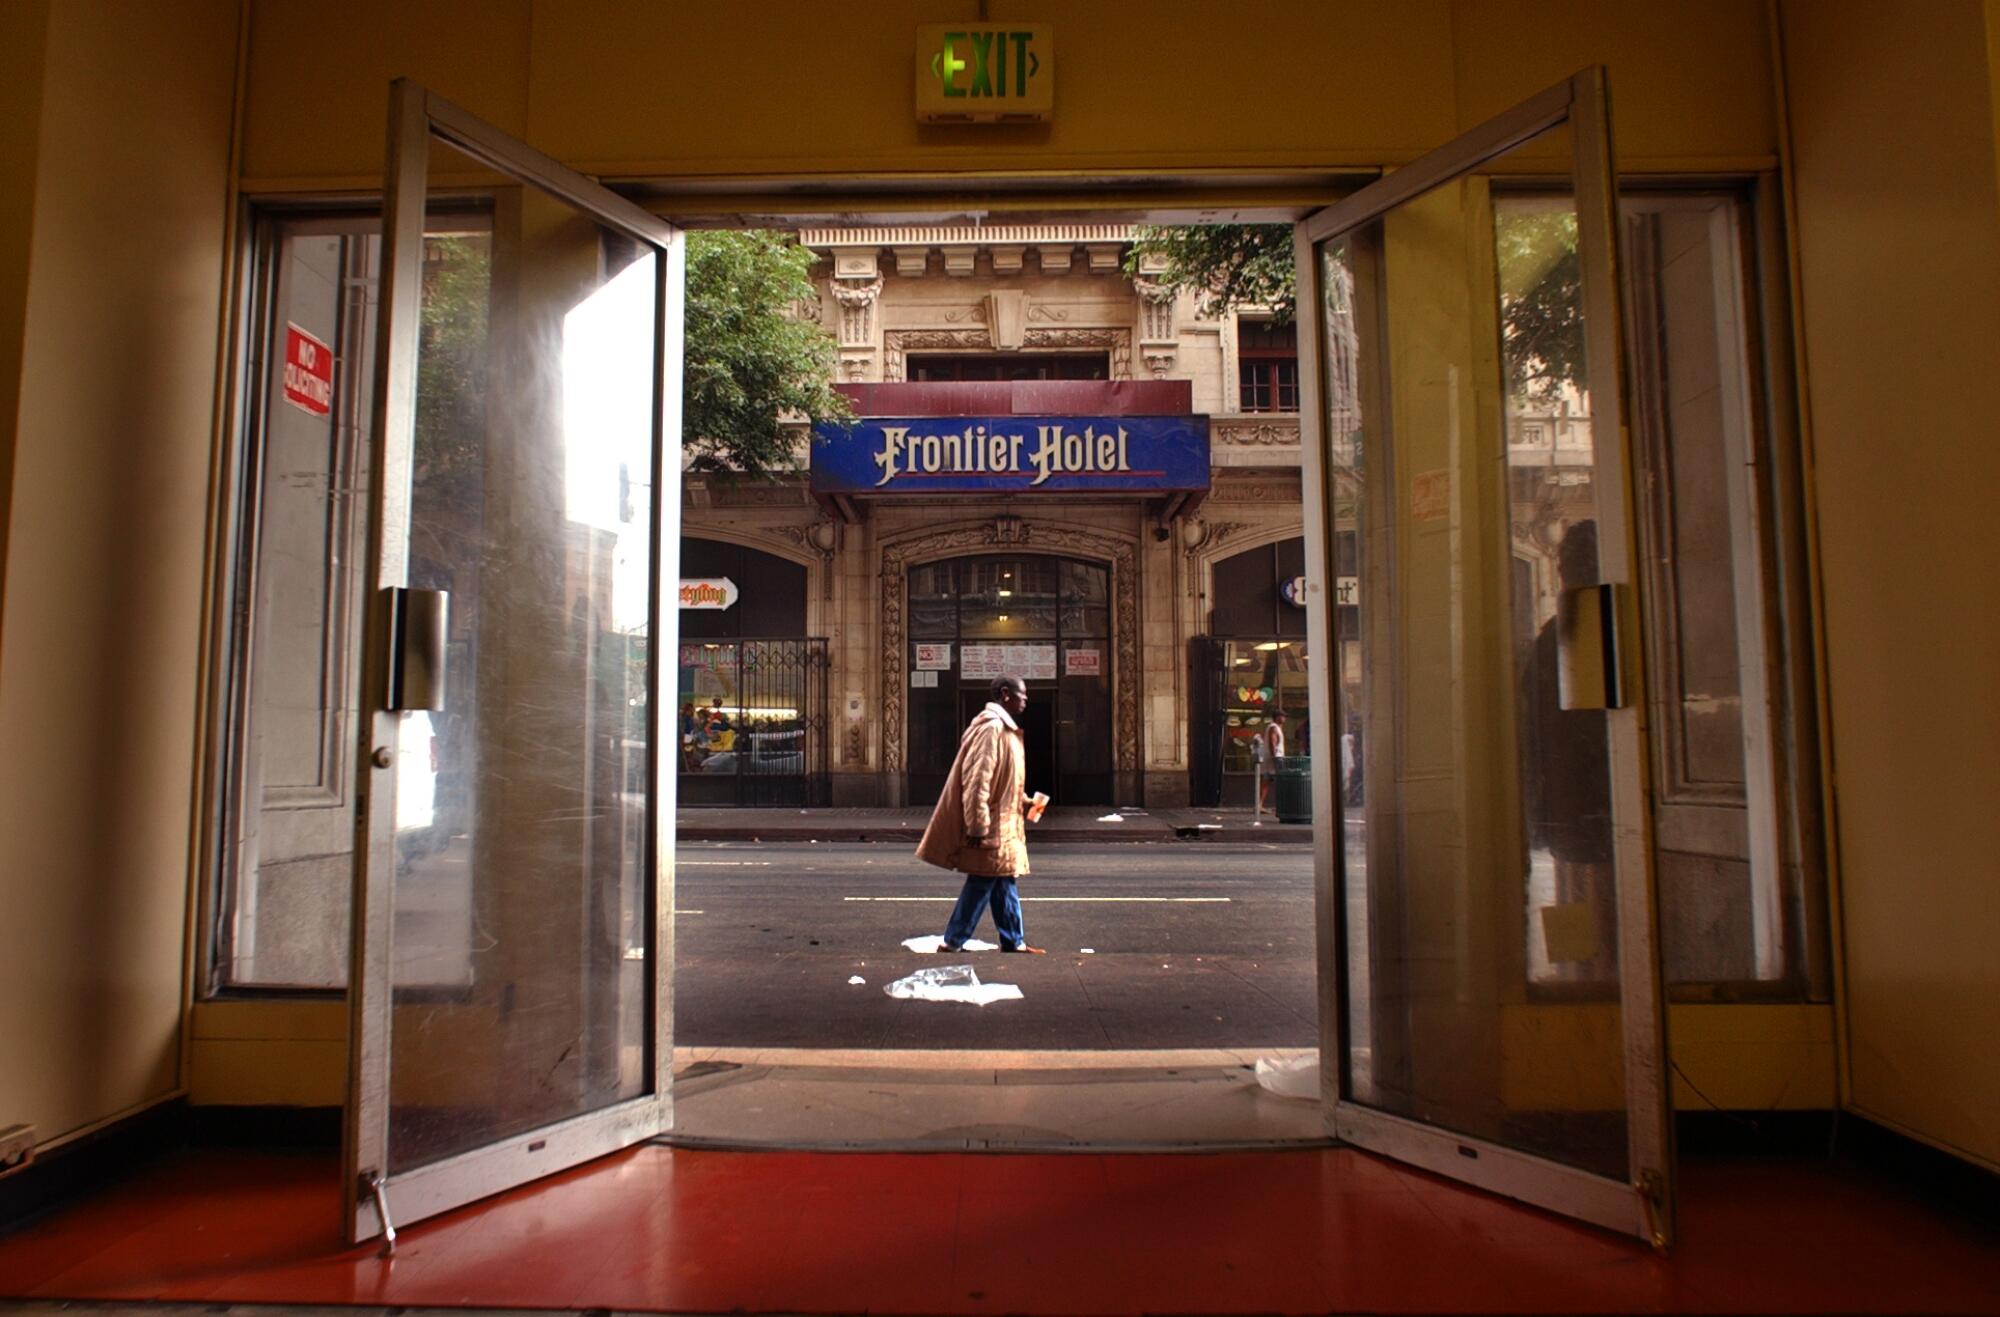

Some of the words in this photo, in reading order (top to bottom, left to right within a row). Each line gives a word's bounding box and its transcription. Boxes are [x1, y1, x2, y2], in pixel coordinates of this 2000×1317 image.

[944, 32, 1033, 97] EXIT
[298, 338, 317, 370] NO
[873, 425, 1023, 486] Frontier
[1028, 425, 1131, 486] Hotel
